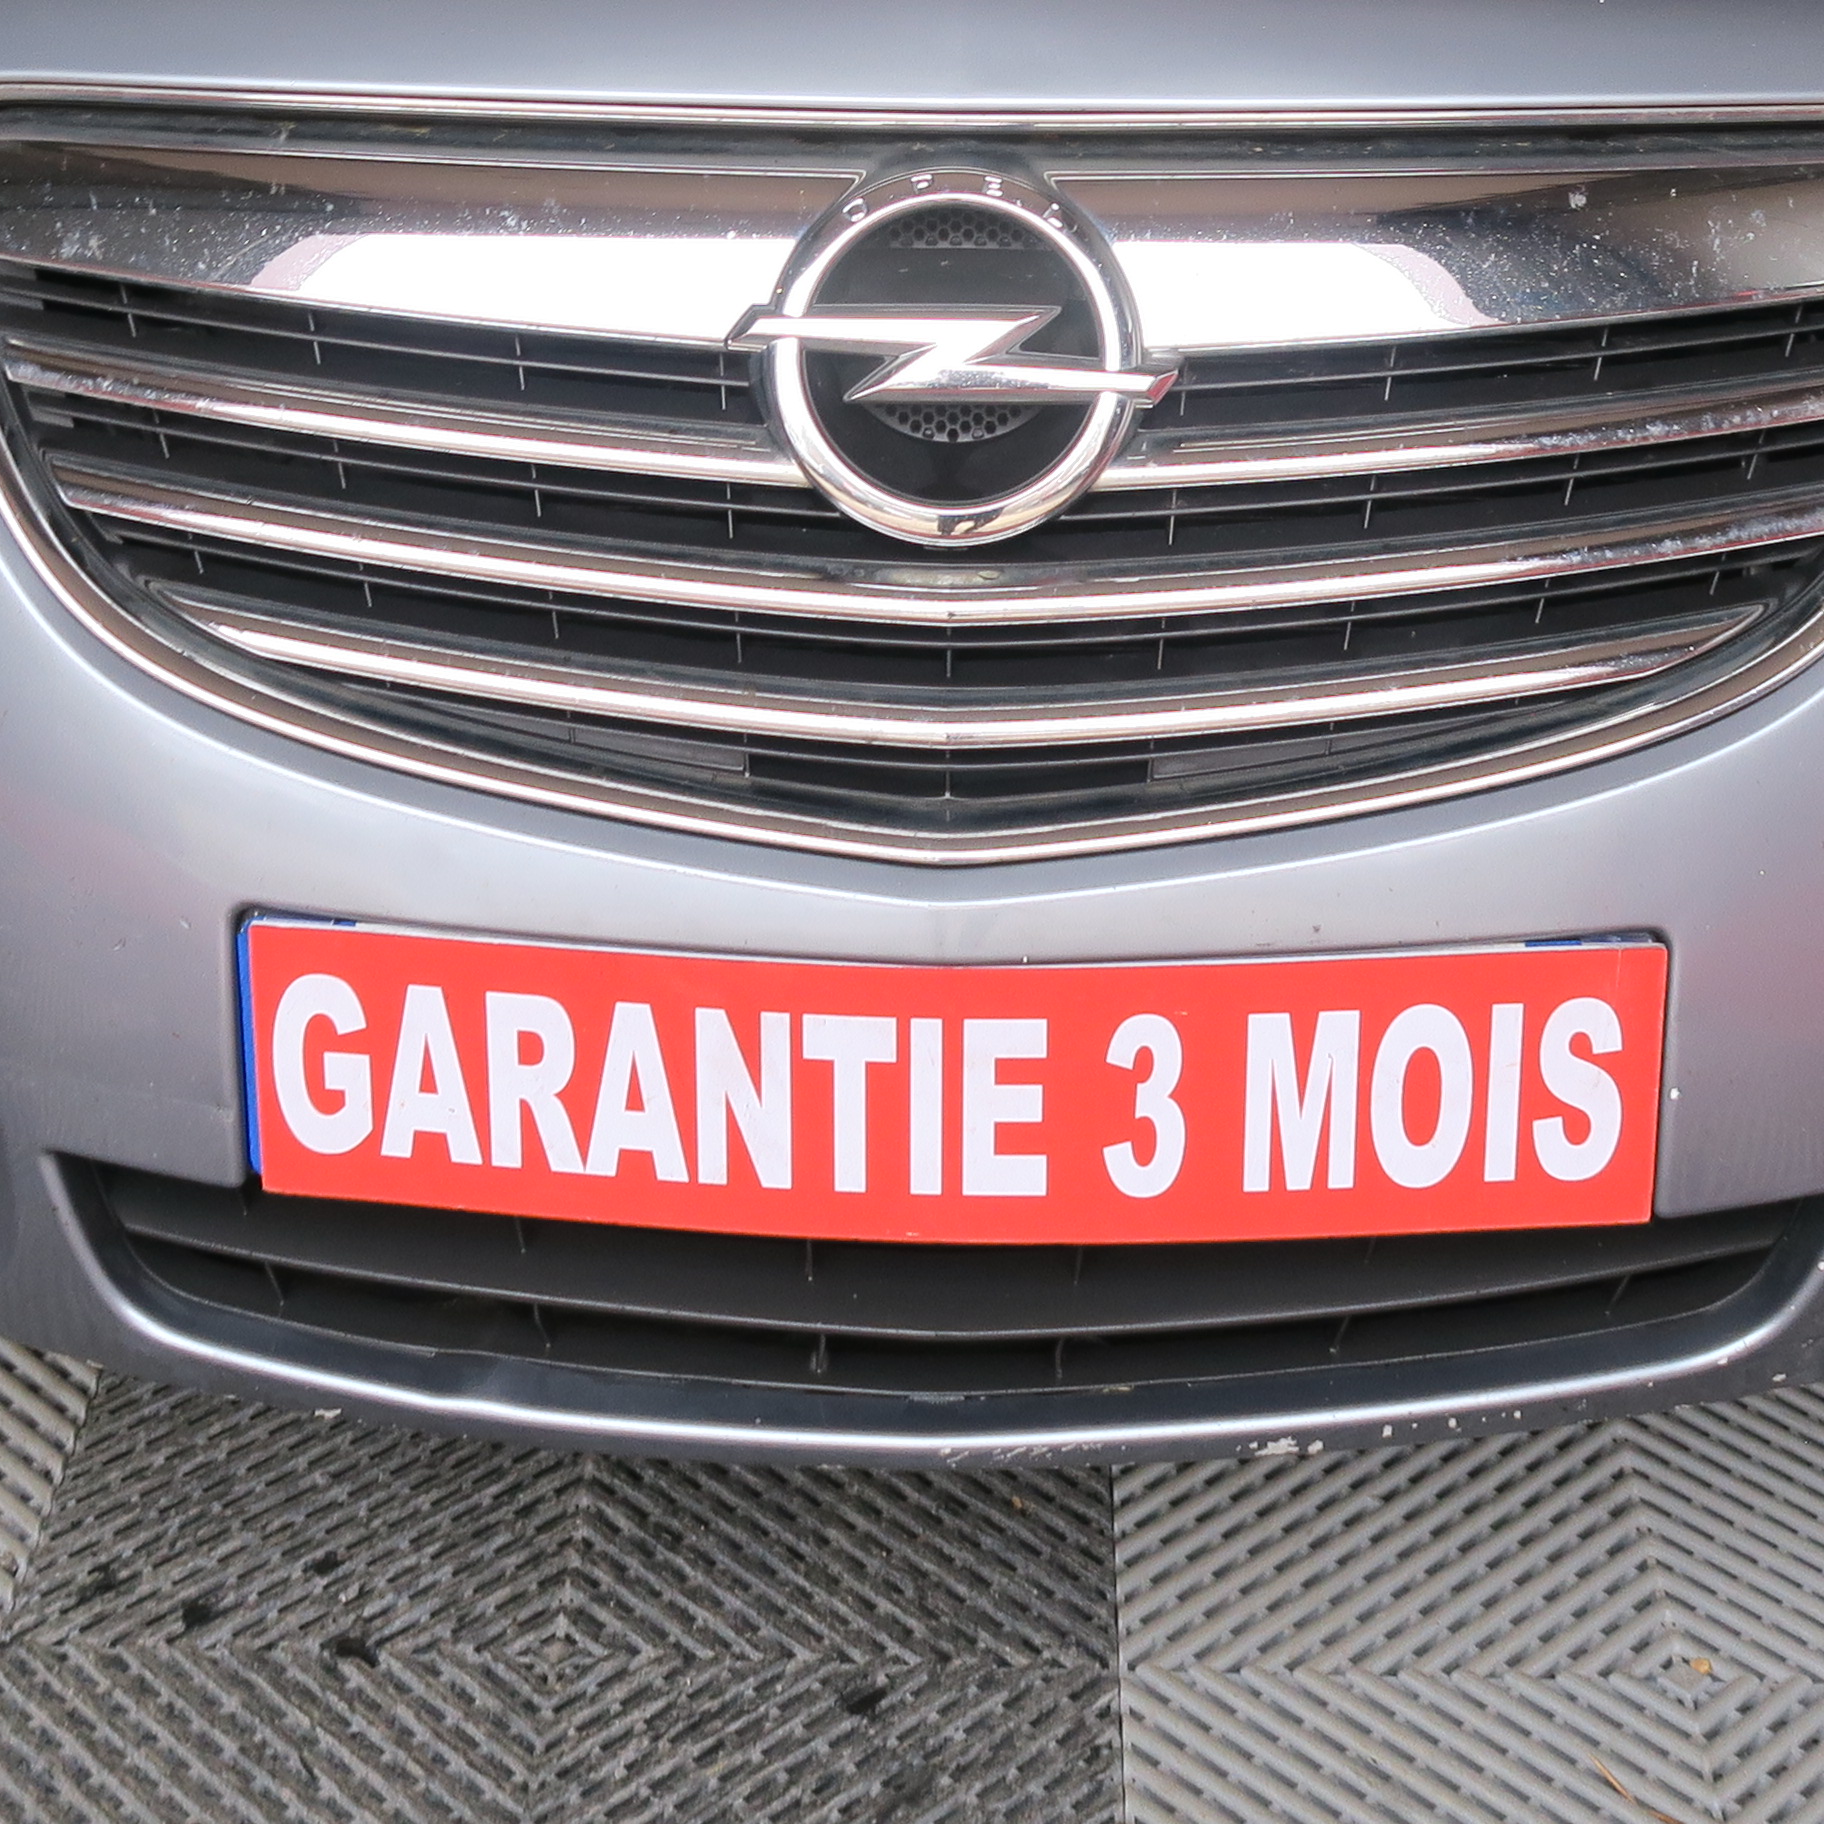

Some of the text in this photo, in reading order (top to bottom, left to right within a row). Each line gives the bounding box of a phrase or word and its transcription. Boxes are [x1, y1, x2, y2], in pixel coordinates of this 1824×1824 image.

[842, 174, 1064, 229] OPEL
[272, 972, 1624, 1199] GARANTIE 3 MOIS
